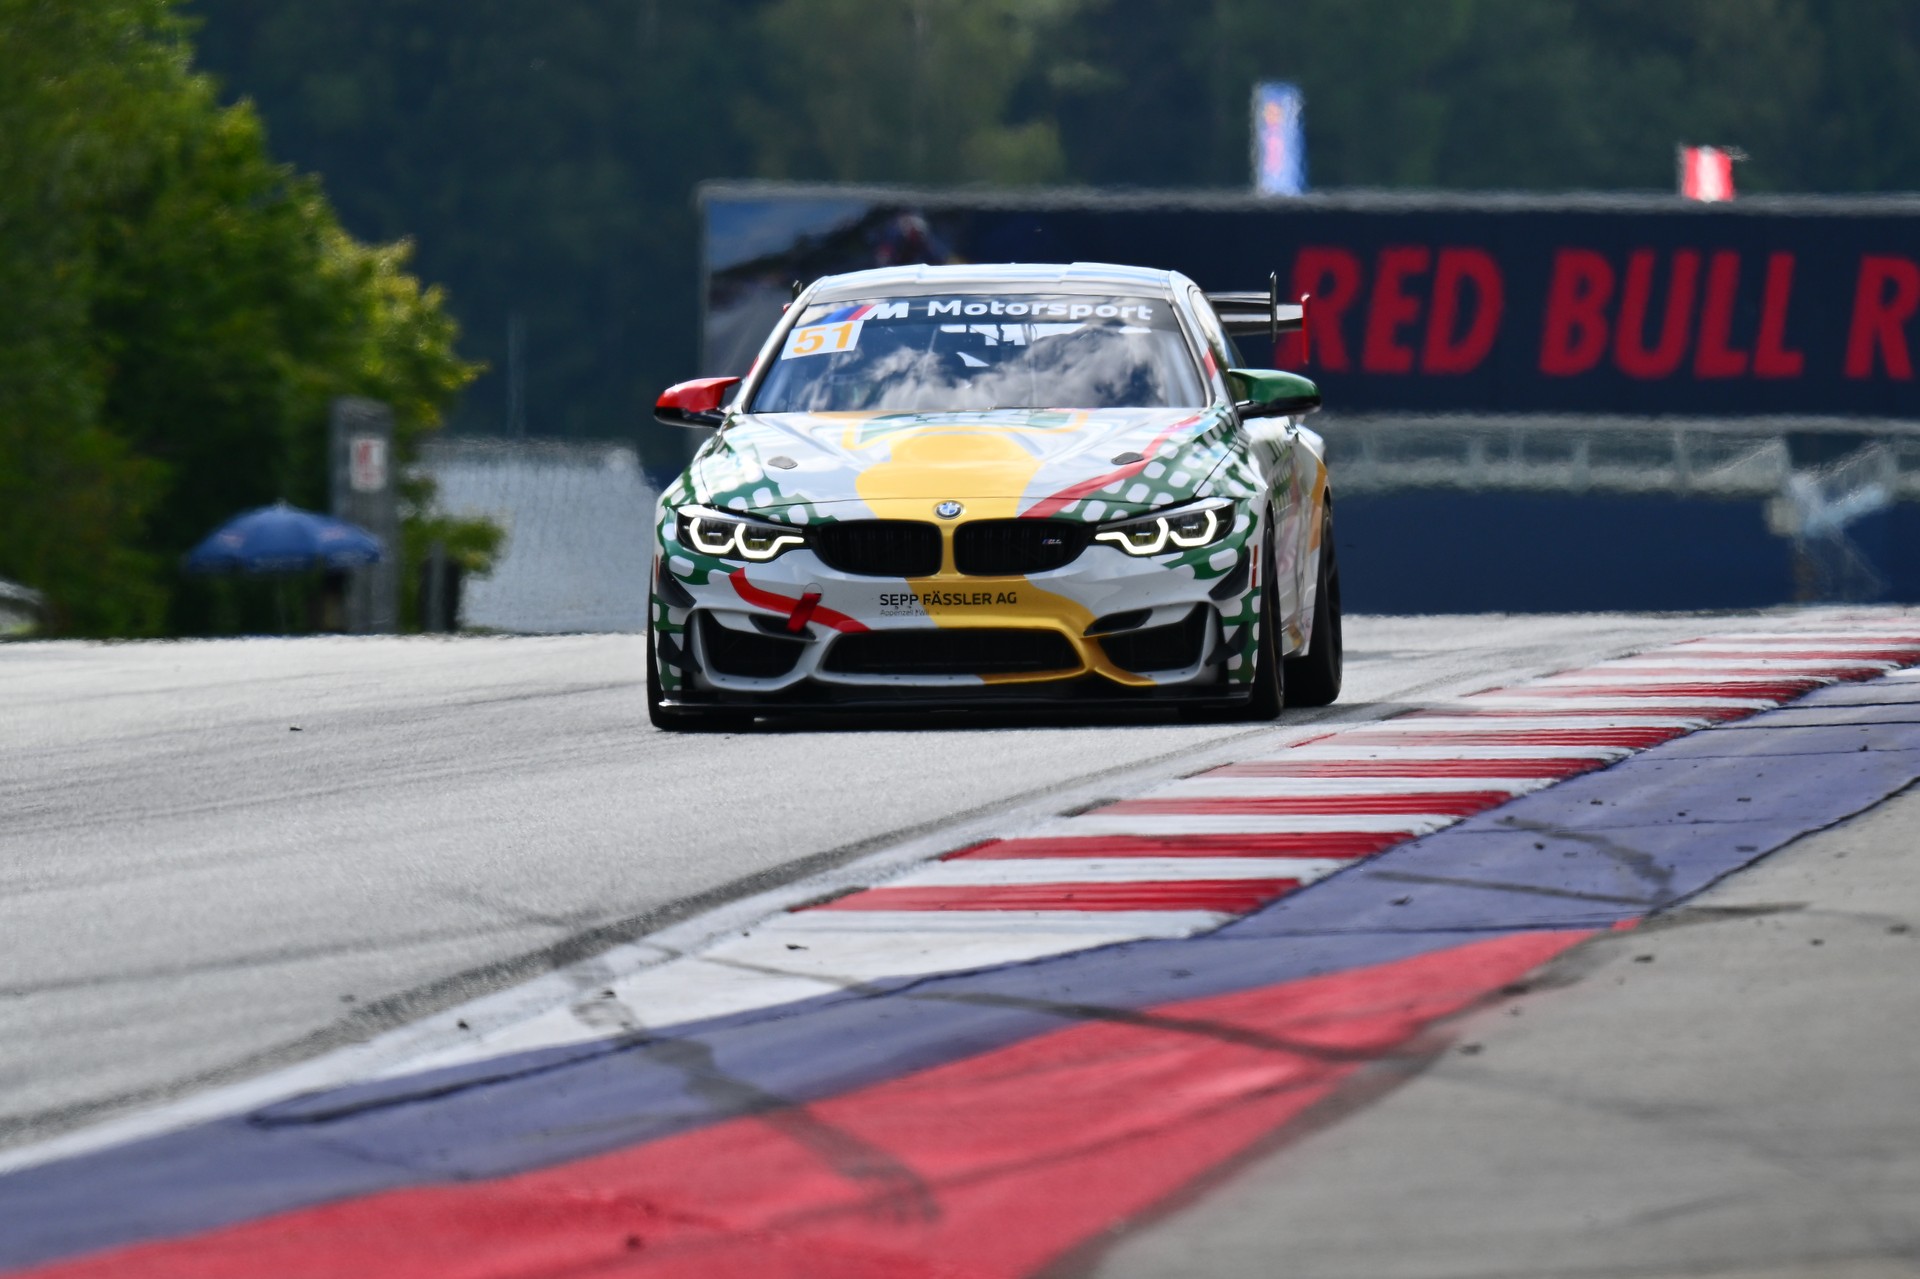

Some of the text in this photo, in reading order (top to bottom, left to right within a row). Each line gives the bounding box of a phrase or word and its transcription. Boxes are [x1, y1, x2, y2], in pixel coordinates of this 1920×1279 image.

[927, 299, 1153, 321] Motorsport
[1275, 245, 1503, 375] RED
[1538, 247, 1805, 379] BULL
[793, 322, 854, 355] 51
[879, 590, 1018, 606] SEPP FÄSSLER AG
[879, 609, 914, 617] Appenzell
